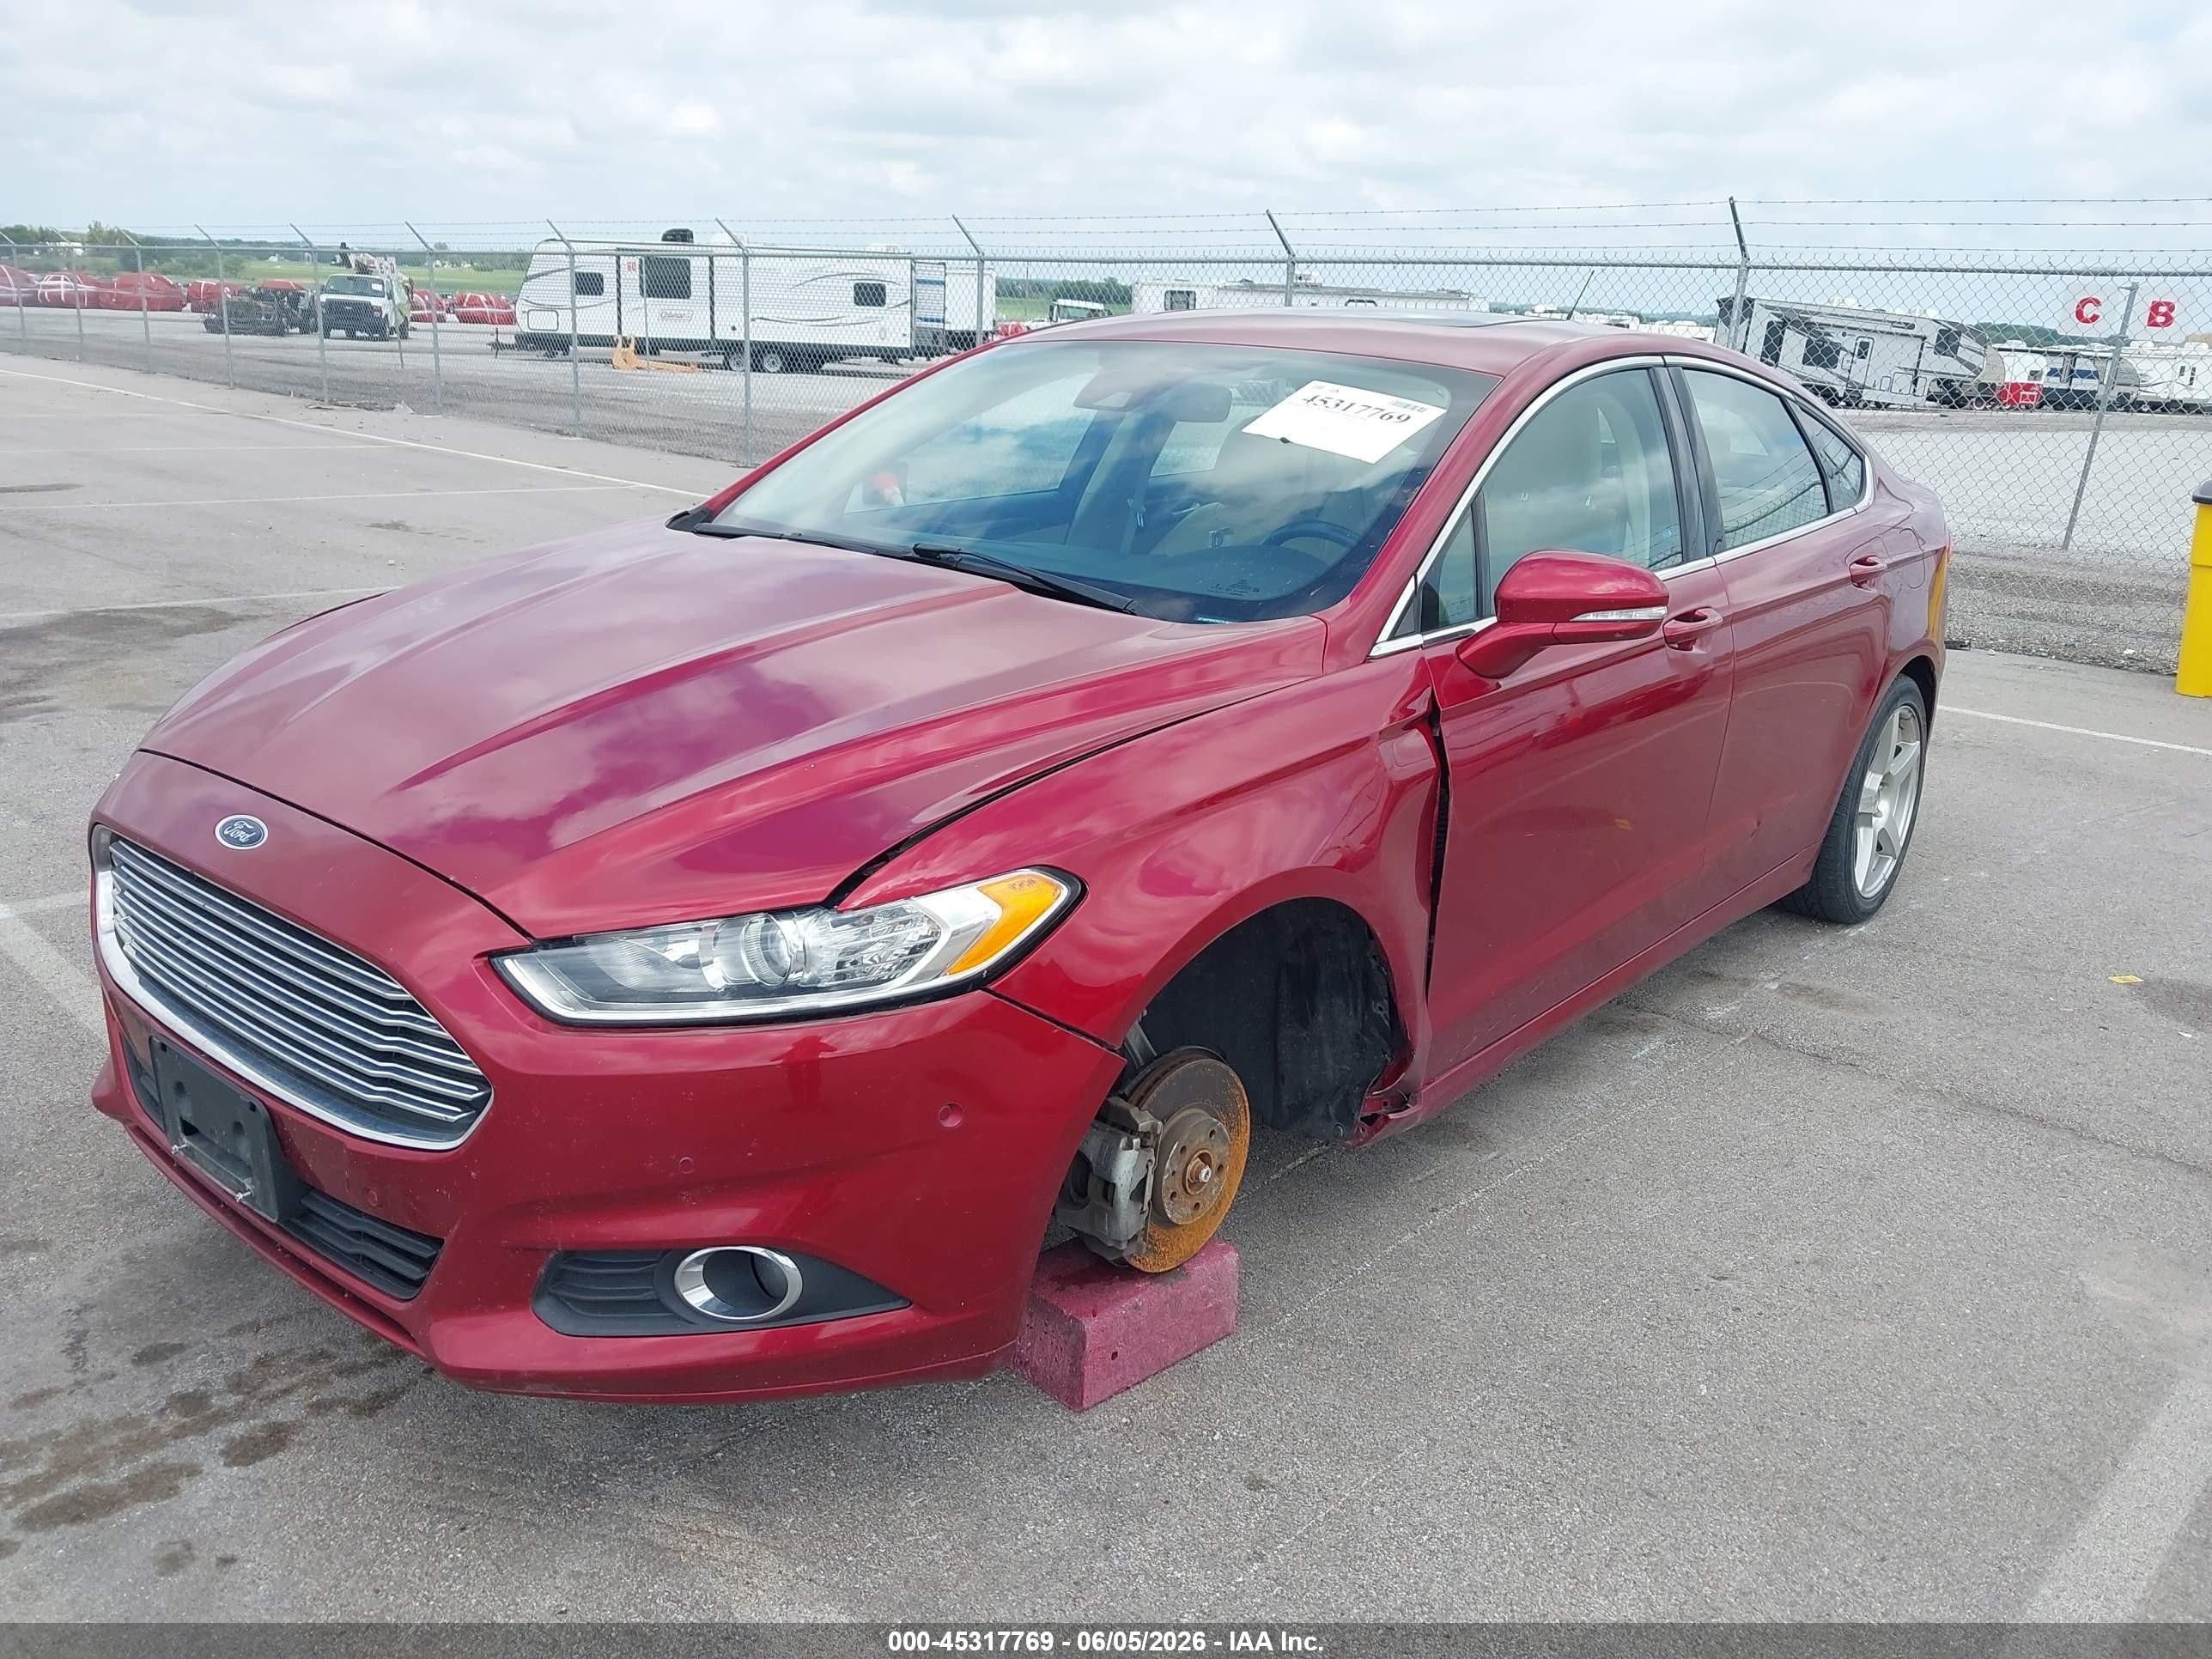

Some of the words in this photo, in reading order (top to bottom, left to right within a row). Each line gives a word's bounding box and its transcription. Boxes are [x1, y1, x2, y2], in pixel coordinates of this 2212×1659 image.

[2075, 296, 2102, 324] C
[2147, 301, 2176, 328] B
[1303, 394, 1412, 423] 45317769
[223, 820, 256, 843] Ford
